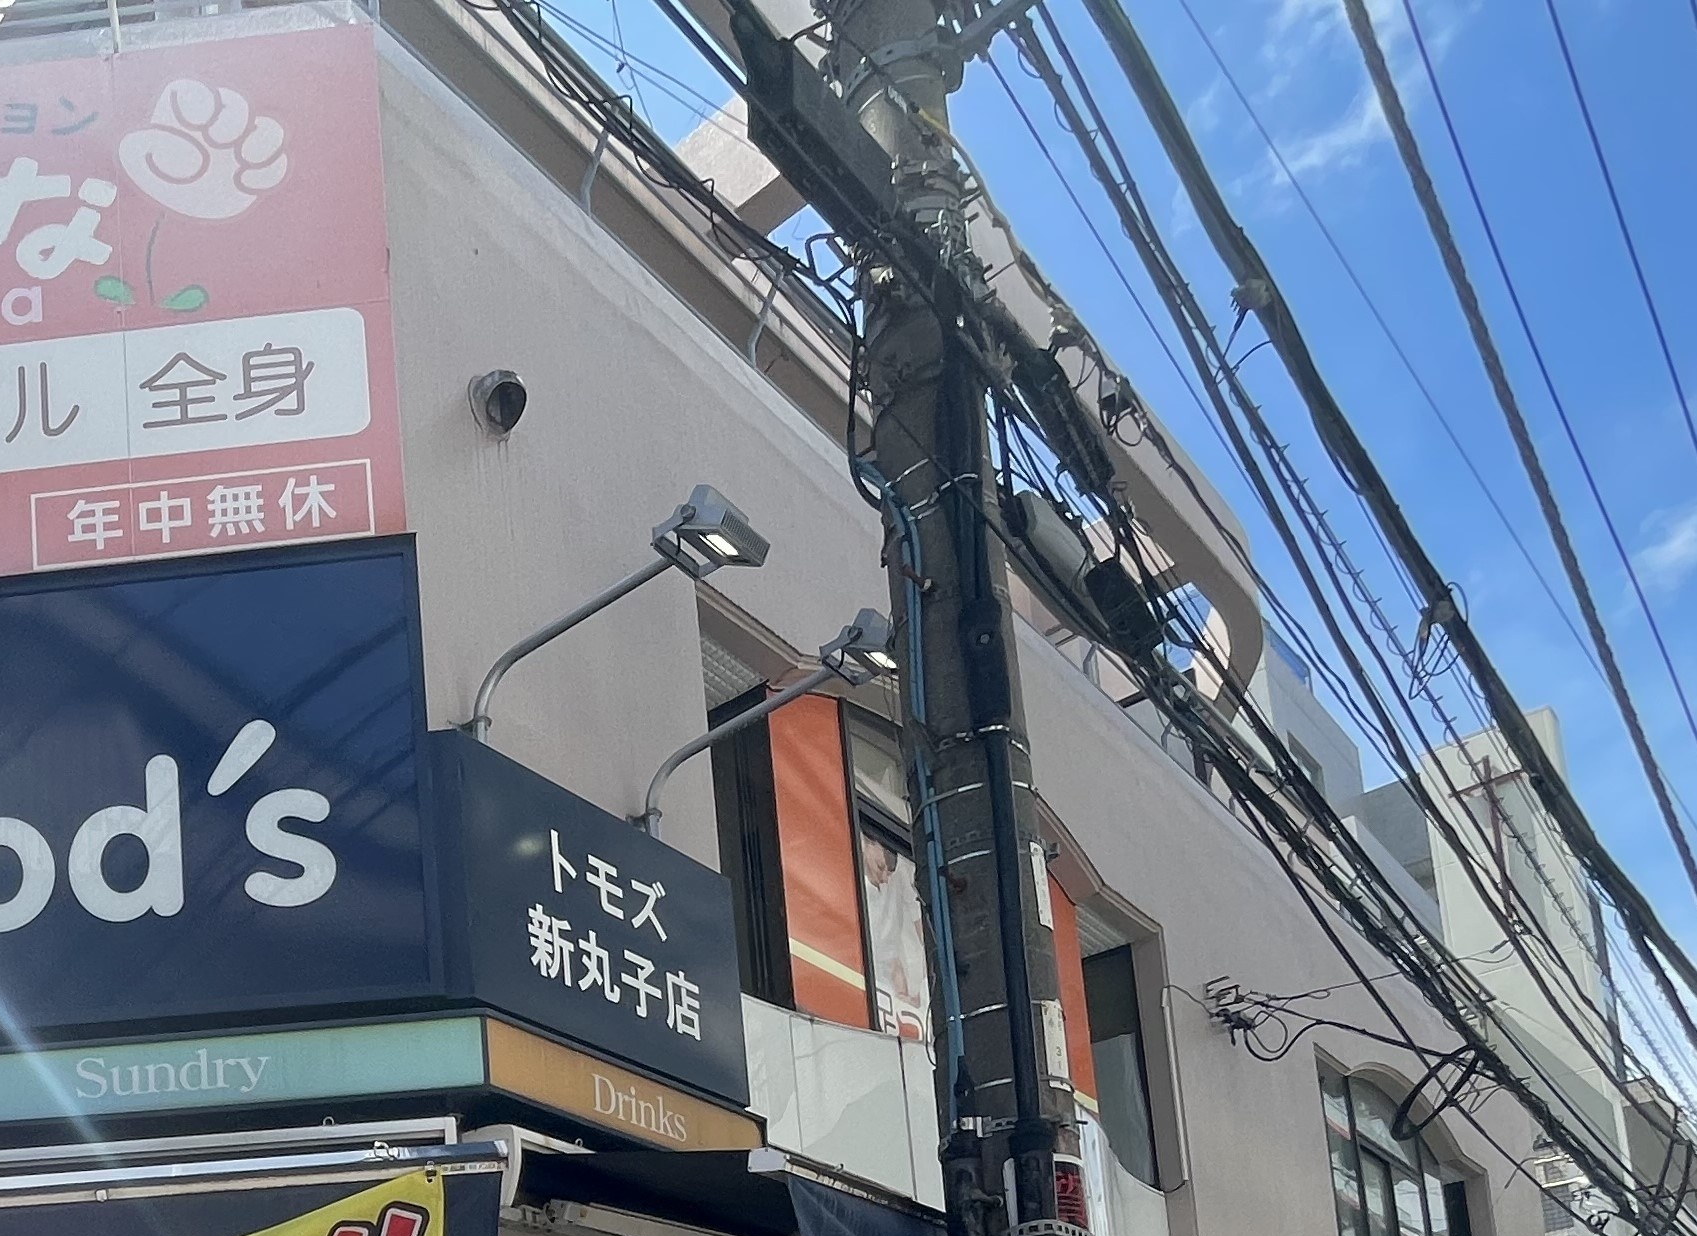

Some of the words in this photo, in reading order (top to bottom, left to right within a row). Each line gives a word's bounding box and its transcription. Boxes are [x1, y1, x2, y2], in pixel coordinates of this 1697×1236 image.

[138, 342, 315, 431] 全身
[65, 477, 337, 548] 年中無休
[550, 829, 668, 942] トモズ
[527, 903, 702, 1041] 新丸子店
[74, 1048, 271, 1102] Sundry
[591, 1073, 688, 1142] Drinks
